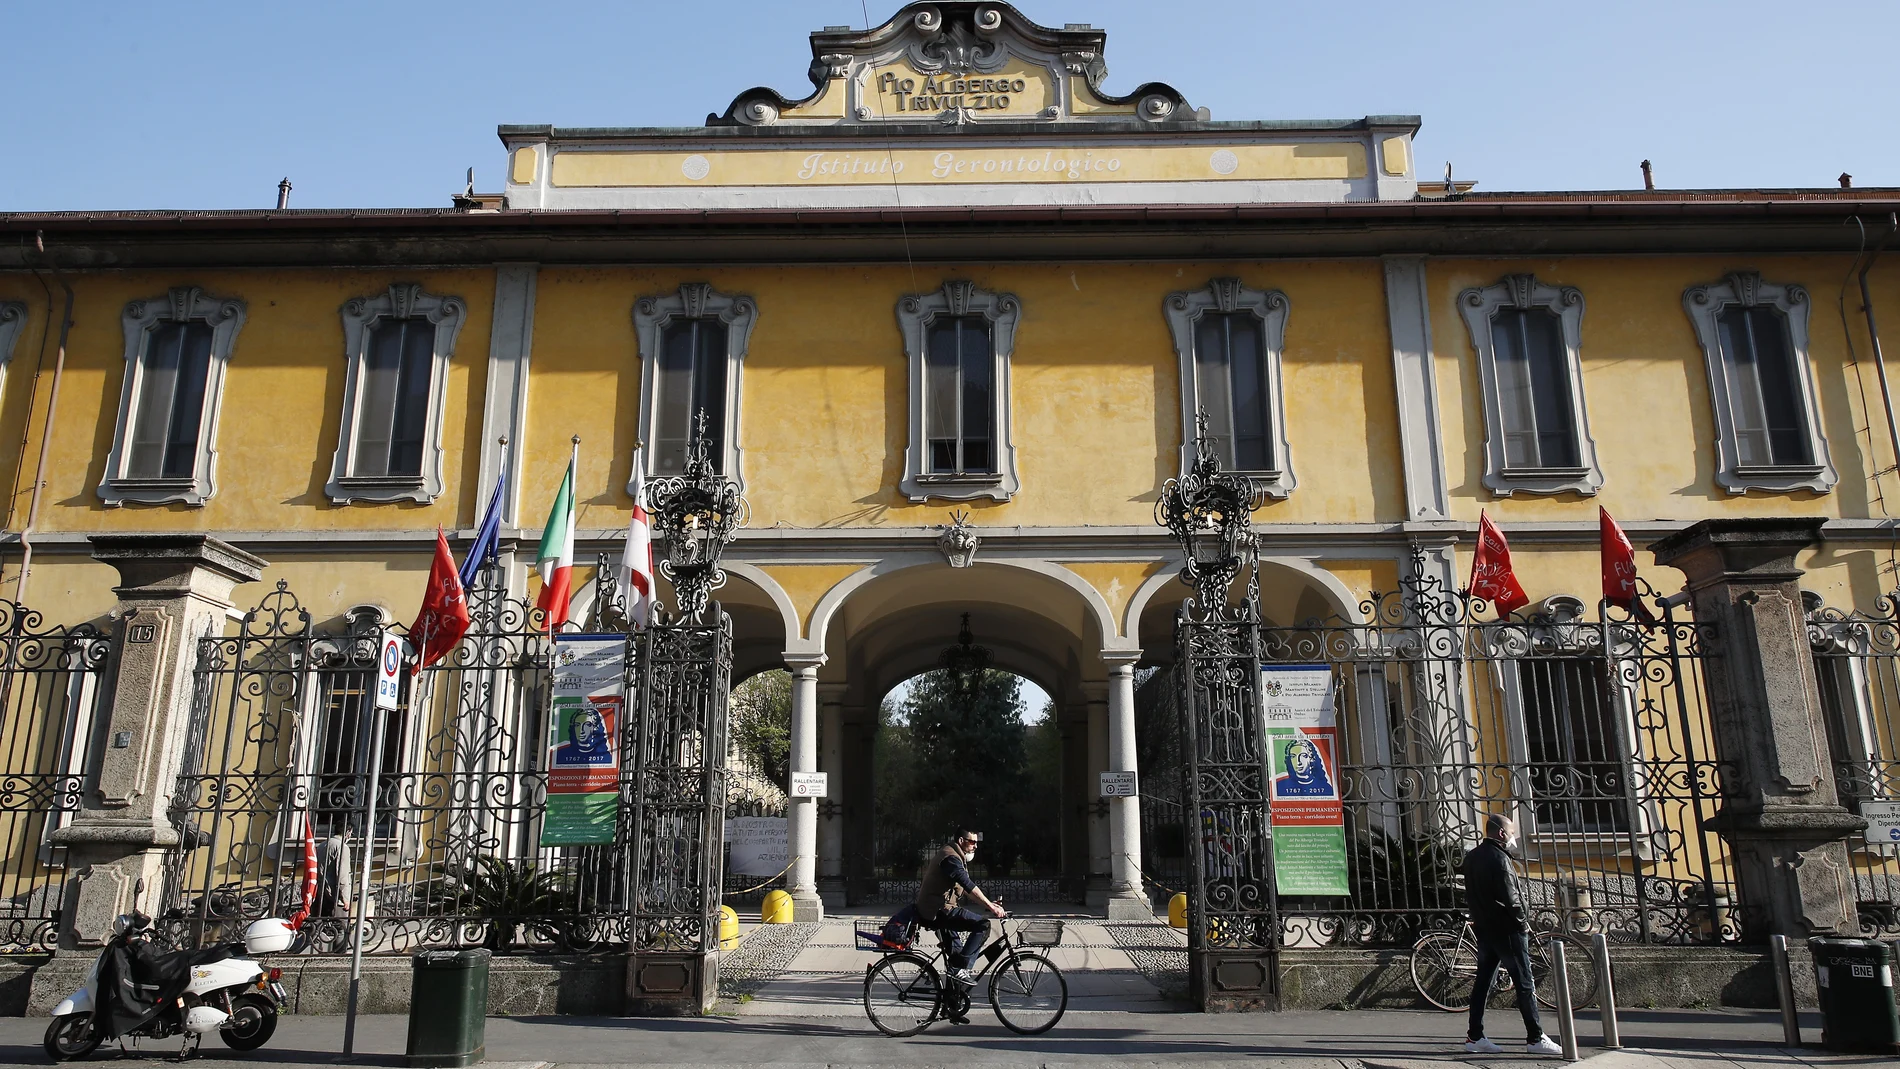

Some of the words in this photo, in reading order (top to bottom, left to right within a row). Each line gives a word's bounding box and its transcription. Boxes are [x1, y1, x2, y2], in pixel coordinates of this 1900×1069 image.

[880, 71, 915, 95] PIO
[922, 75, 1026, 96] ALBERGO
[896, 90, 1011, 110] TRIVULZIO
[797, 152, 904, 180] Istituto
[931, 152, 1121, 179] Gerontologico
[1484, 535, 1501, 551] CGIL
[136, 626, 152, 640] 15
[1853, 966, 1873, 977] BNE
